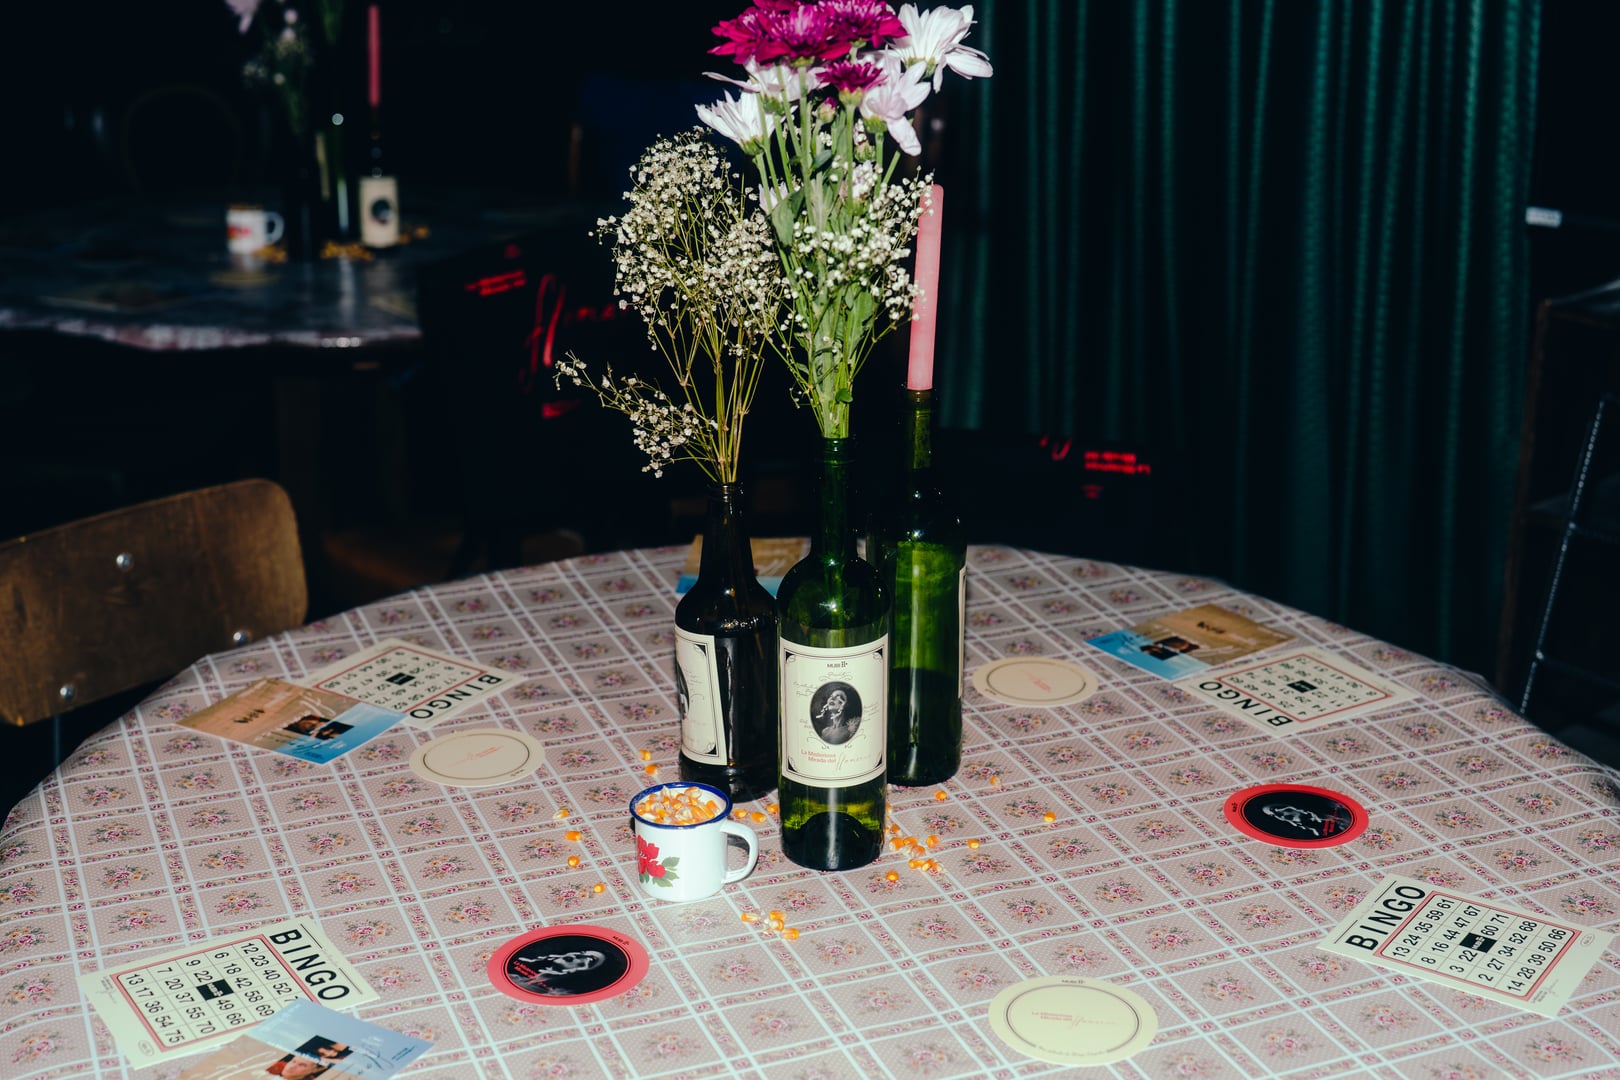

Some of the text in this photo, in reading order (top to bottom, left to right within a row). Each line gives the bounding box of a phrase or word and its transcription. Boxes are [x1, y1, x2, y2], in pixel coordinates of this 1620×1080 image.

[409, 674, 502, 719] BINGO
[1199, 681, 1292, 727] BINGO
[1346, 885, 1425, 950] BINGO
[1392, 898, 1455, 957] 13 24 35 59 61
[1421, 905, 1481, 964] 8 16 44 47 67
[1449, 965, 1465, 973] 3
[1458, 949, 1478, 962] 22
[1480, 925, 1499, 936] 60
[1490, 913, 1509, 924] 71
[241, 942, 259, 954] 12
[250, 955, 269, 967] 23
[263, 969, 281, 980] 40
[272, 982, 292, 995] 52
[270, 929, 349, 1000] BINGO
[1478, 920, 1537, 982] 2 27 34 52 68
[1507, 980, 1525, 991] 14
[1516, 966, 1536, 980] 28
[1527, 954, 1546, 966] 39
[1538, 941, 1557, 953] 50
[1548, 928, 1566, 940] 66
[126, 974, 185, 1043] 13 17 36 54 75
[164, 978, 184, 990] 20
[175, 992, 195, 1003] 37
[185, 1006, 205, 1019] 55
[197, 1020, 216, 1033] 70
[185, 959, 201, 967] 9
[193, 970, 213, 983] 22
[217, 999, 234, 1010] 49
[226, 1013, 245, 1025] 66
[223, 963, 242, 975] 18
[235, 977, 253, 989] 42
[244, 990, 264, 1003] 58
[255, 1004, 275, 1016] 69
